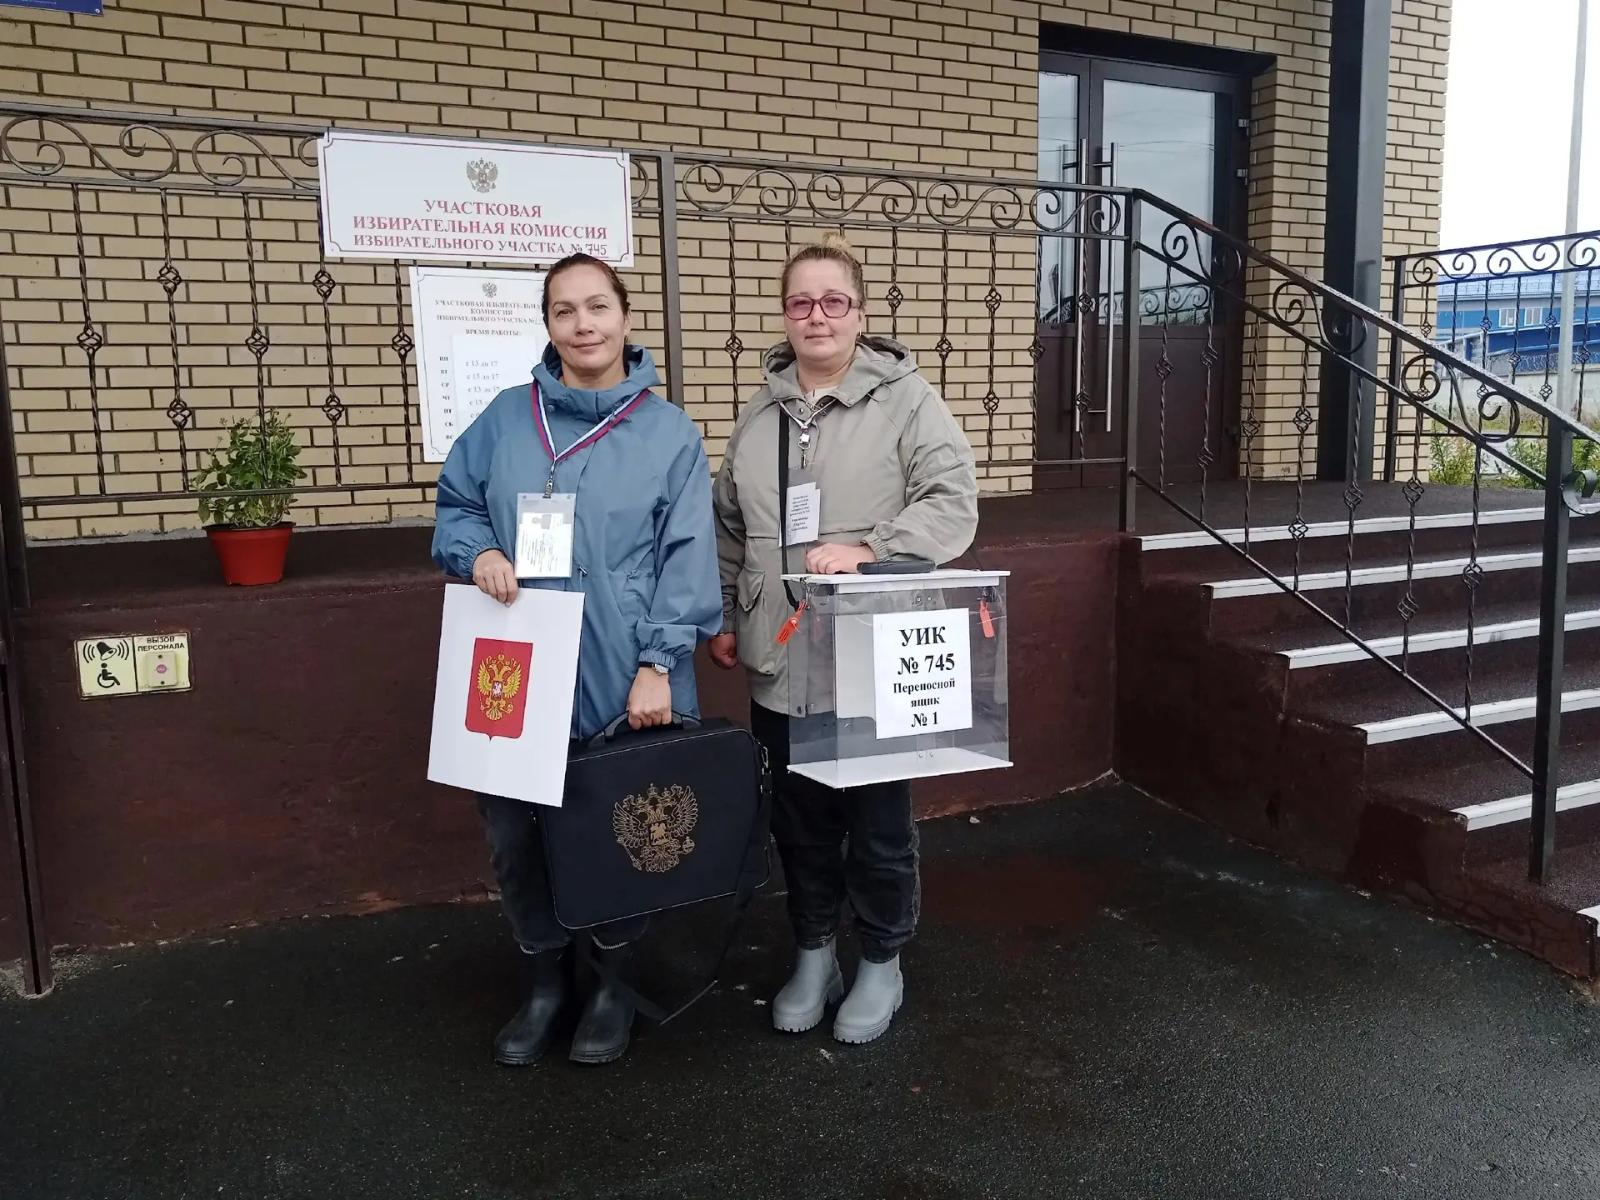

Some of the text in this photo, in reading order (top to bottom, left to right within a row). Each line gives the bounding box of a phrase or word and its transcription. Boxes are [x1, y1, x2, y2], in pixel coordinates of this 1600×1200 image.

[424, 199, 542, 218] УЧАСТКОВАЯ
[353, 215, 608, 240] ИЗБИРАТЕЛЬНАЯ КОМИССИЯ
[353, 234, 607, 255] ИЗБИРАТЕЛЬНОГО УЧАСТКА № 745
[898, 626, 946, 647] УИК
[138, 643, 185, 652] ПЕРСОНАЛА
[897, 653, 955, 675] № 745
[893, 678, 956, 694] Переносной
[910, 697, 940, 708] ящик
[911, 711, 938, 727] № 1
